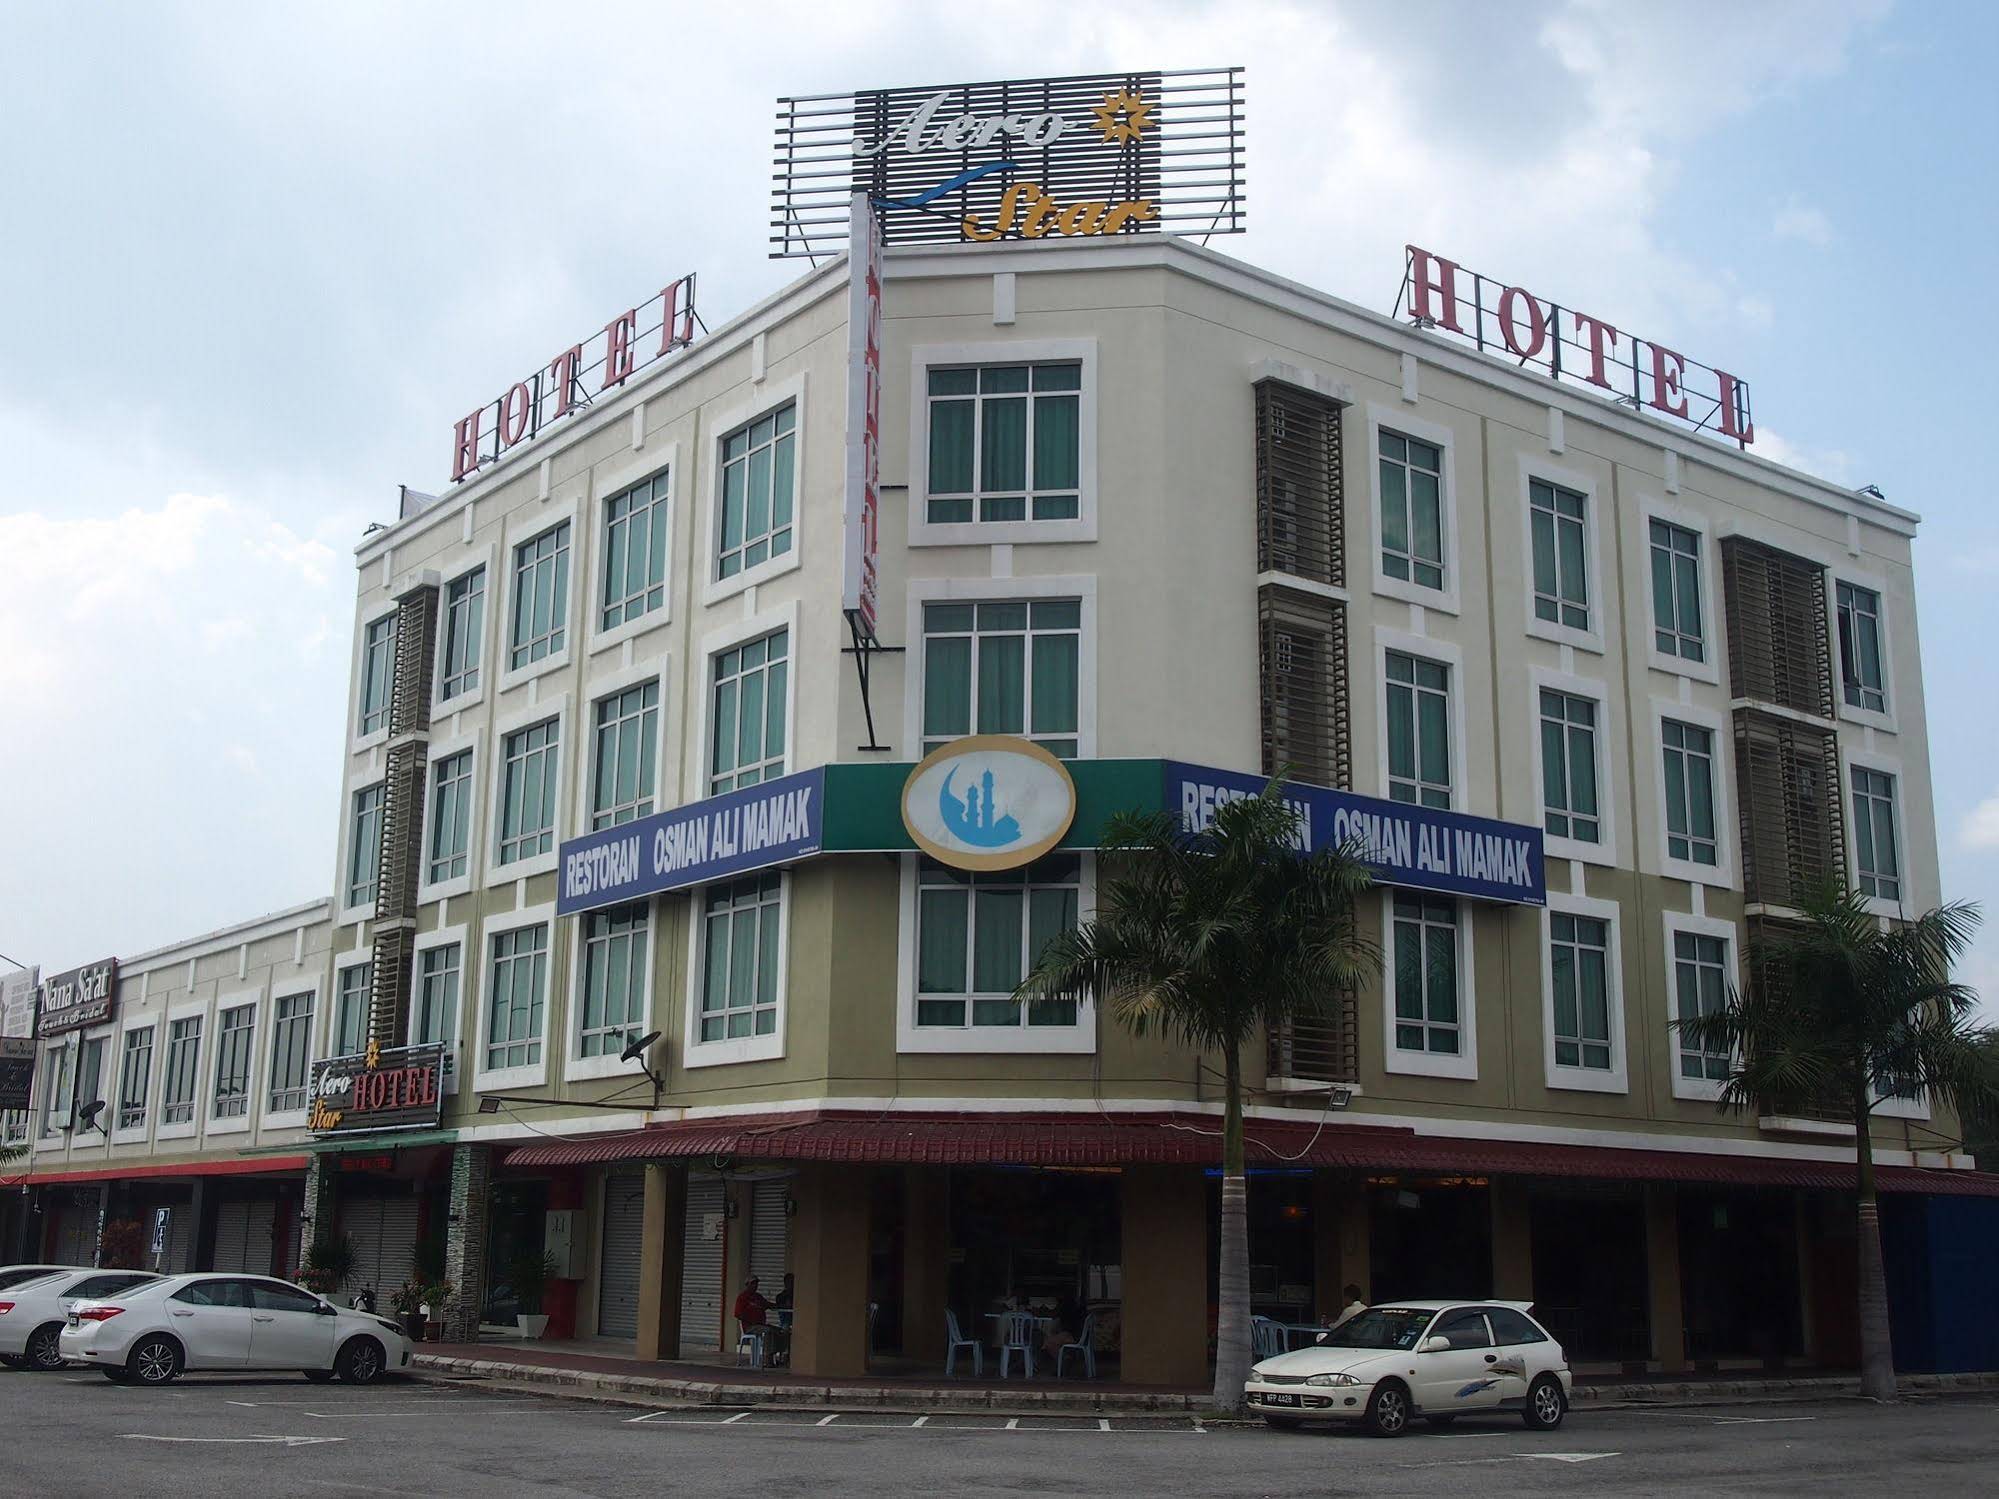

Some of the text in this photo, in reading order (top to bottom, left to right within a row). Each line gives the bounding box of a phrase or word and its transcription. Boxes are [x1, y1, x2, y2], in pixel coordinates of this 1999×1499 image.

[852, 92, 1079, 157] Aero
[962, 183, 1159, 241] Star
[1406, 245, 1754, 443] HOTEL
[450, 278, 694, 483] HOTEL
[565, 786, 812, 898] RESTORAN OSMAN ALI MAMAK
[1333, 807, 1412, 868] OSMAN
[1417, 822, 1451, 875] ALI
[1455, 828, 1533, 887] MAMAK
[40, 978, 73, 1014] Nana
[308, 1099, 342, 1129] Star
[310, 1066, 437, 1113] Aero HOTEL
